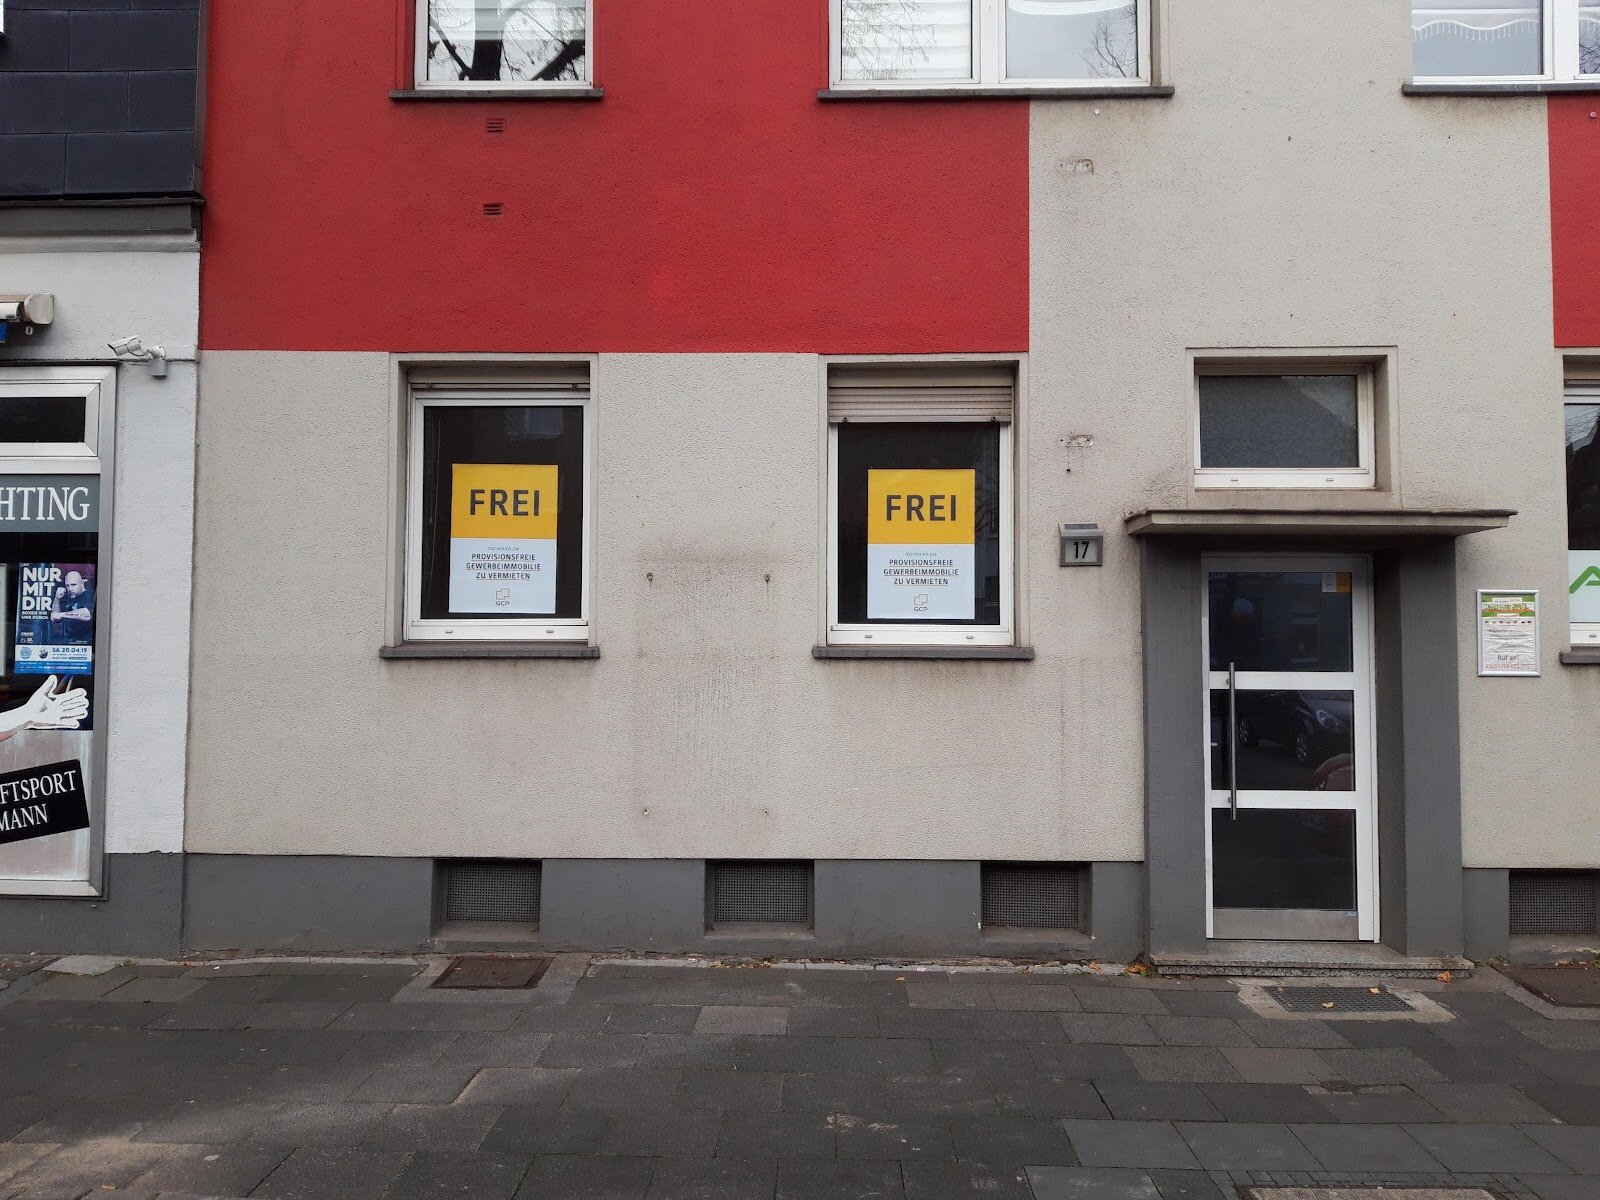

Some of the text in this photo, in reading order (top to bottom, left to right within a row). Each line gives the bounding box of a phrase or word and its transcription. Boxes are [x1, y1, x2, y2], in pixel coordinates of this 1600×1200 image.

[469, 489, 540, 516] FREI
[886, 494, 957, 521] FREI
[471, 553, 536, 561] PROVISIONSFREIE
[1073, 541, 1090, 559] 17
[22, 567, 62, 582] NUR
[883, 568, 960, 576] GEWERBEIMMOBILIE
[22, 582, 55, 597] MIT
[21, 596, 52, 611] DIR
[0, 770, 76, 805] FTSPORT
